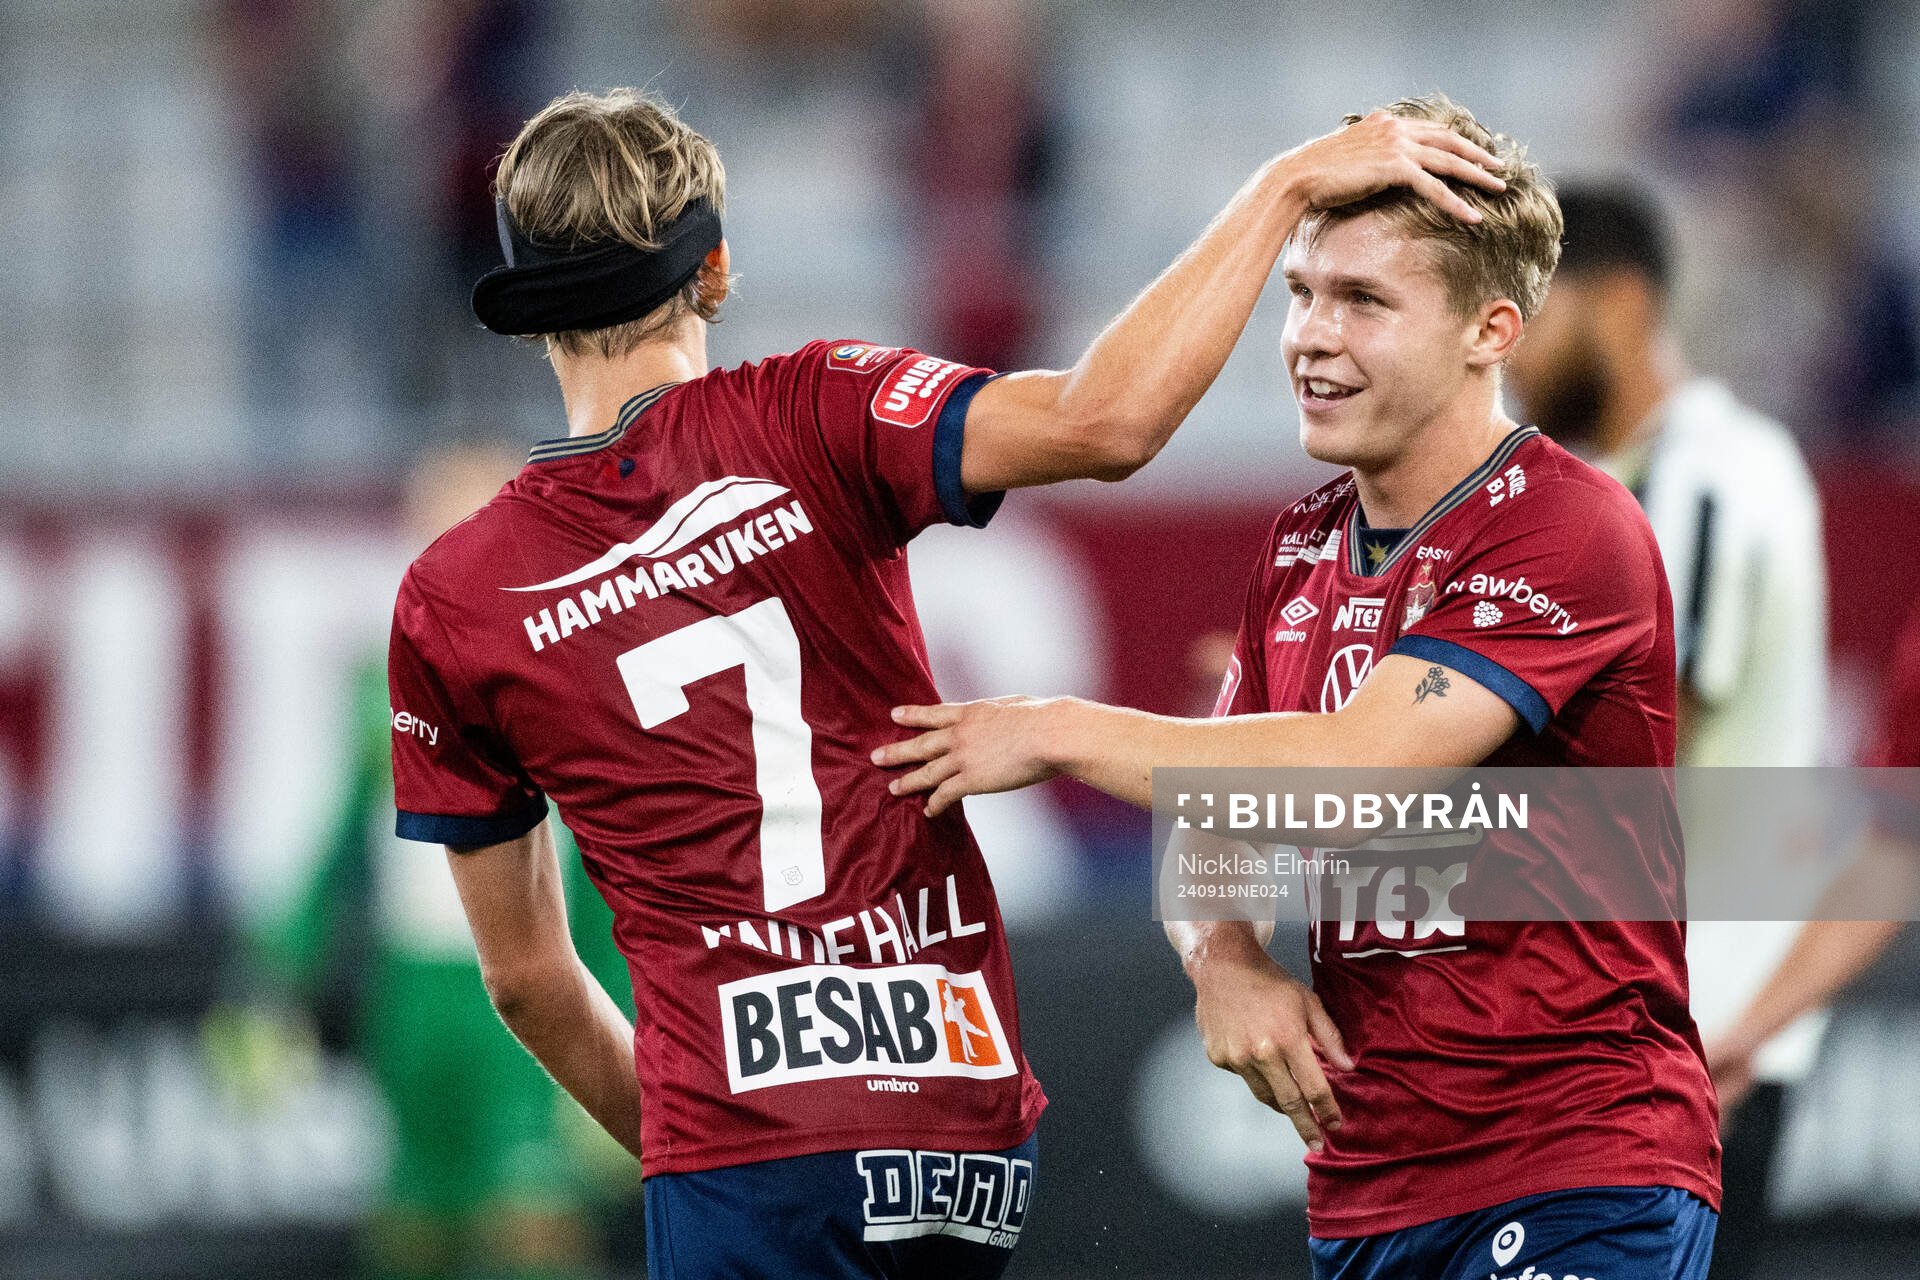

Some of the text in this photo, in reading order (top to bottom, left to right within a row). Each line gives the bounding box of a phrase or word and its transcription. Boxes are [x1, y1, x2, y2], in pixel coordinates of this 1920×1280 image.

[523, 500, 814, 652] HAMMARVKEN
[1275, 628, 1307, 643] umbro
[390, 706, 439, 746] erry
[616, 596, 826, 913] 7
[732, 977, 938, 1078] BESAB
[866, 1077, 920, 1094] umbro
[855, 1149, 1033, 1233] DEMO
